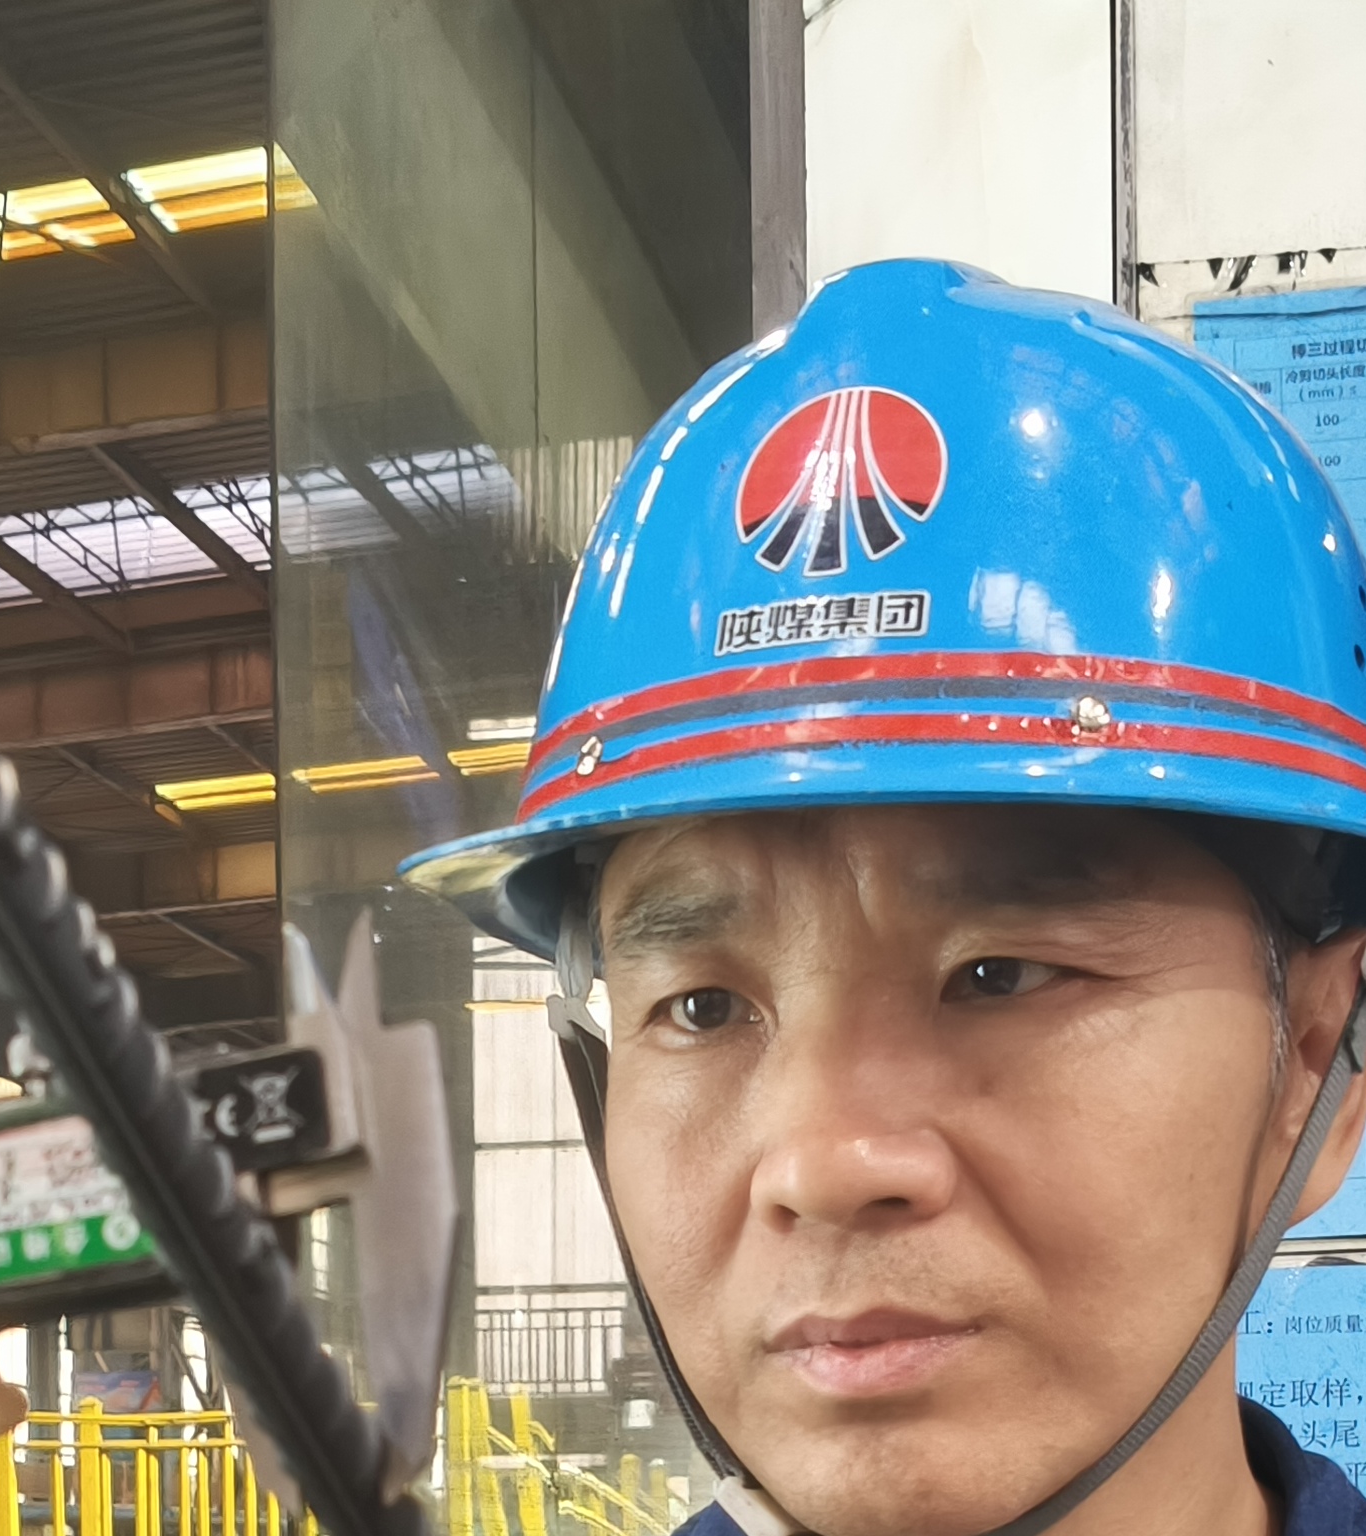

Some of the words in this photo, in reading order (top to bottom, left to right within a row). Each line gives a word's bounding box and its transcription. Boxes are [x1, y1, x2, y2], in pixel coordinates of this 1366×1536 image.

[1315, 412, 1340, 427] 100
[715, 592, 928, 654] 陕煤集团
[1289, 1419, 1361, 1449] 头尾
